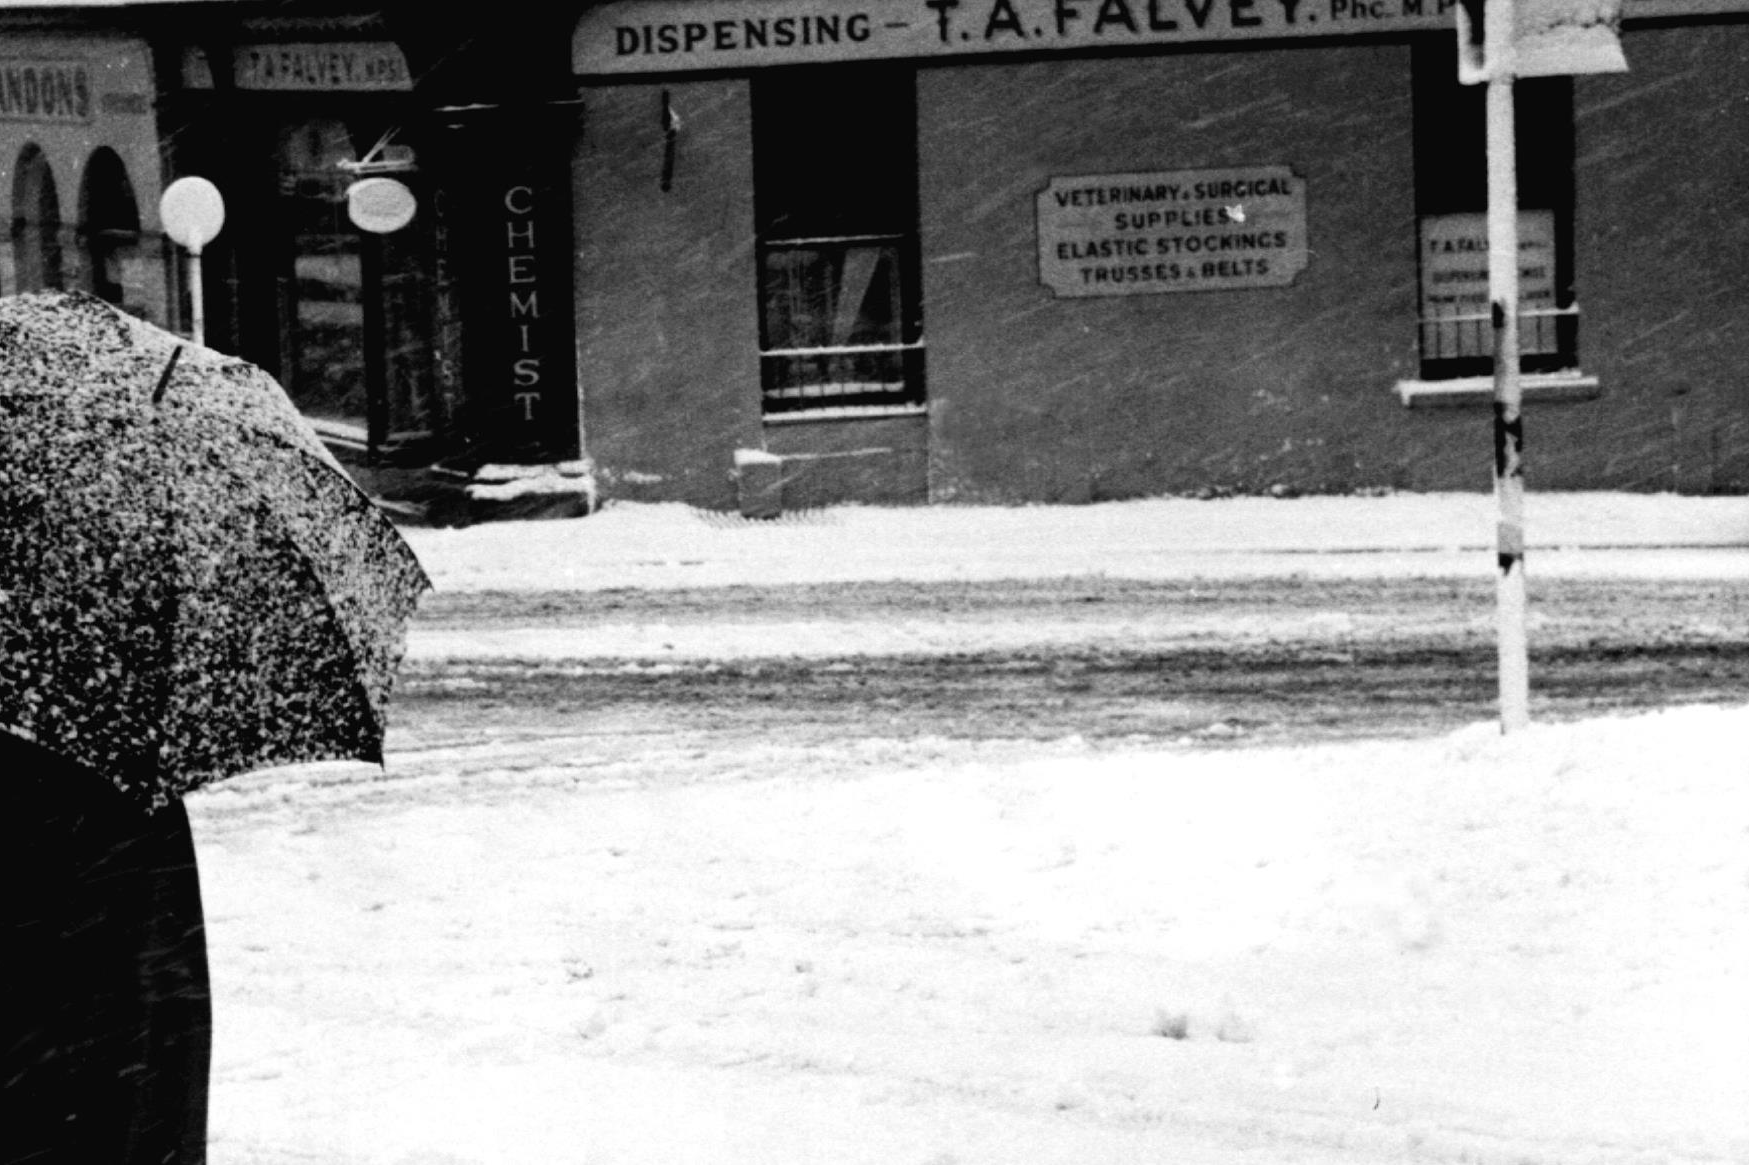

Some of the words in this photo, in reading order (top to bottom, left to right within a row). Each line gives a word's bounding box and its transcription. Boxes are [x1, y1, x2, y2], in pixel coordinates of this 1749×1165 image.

[615, 13, 871, 55] DISPENSING
[1055, 184, 1180, 207] VETERINARY
[1194, 178, 1292, 200] SURGICAL
[1057, 238, 1149, 260] ELASTIC
[1156, 231, 1287, 255] STOCKINGS
[1081, 263, 1181, 284] TRUSSES
[1202, 258, 1269, 277] BELTS
[504, 185, 542, 422] CHEMIST
